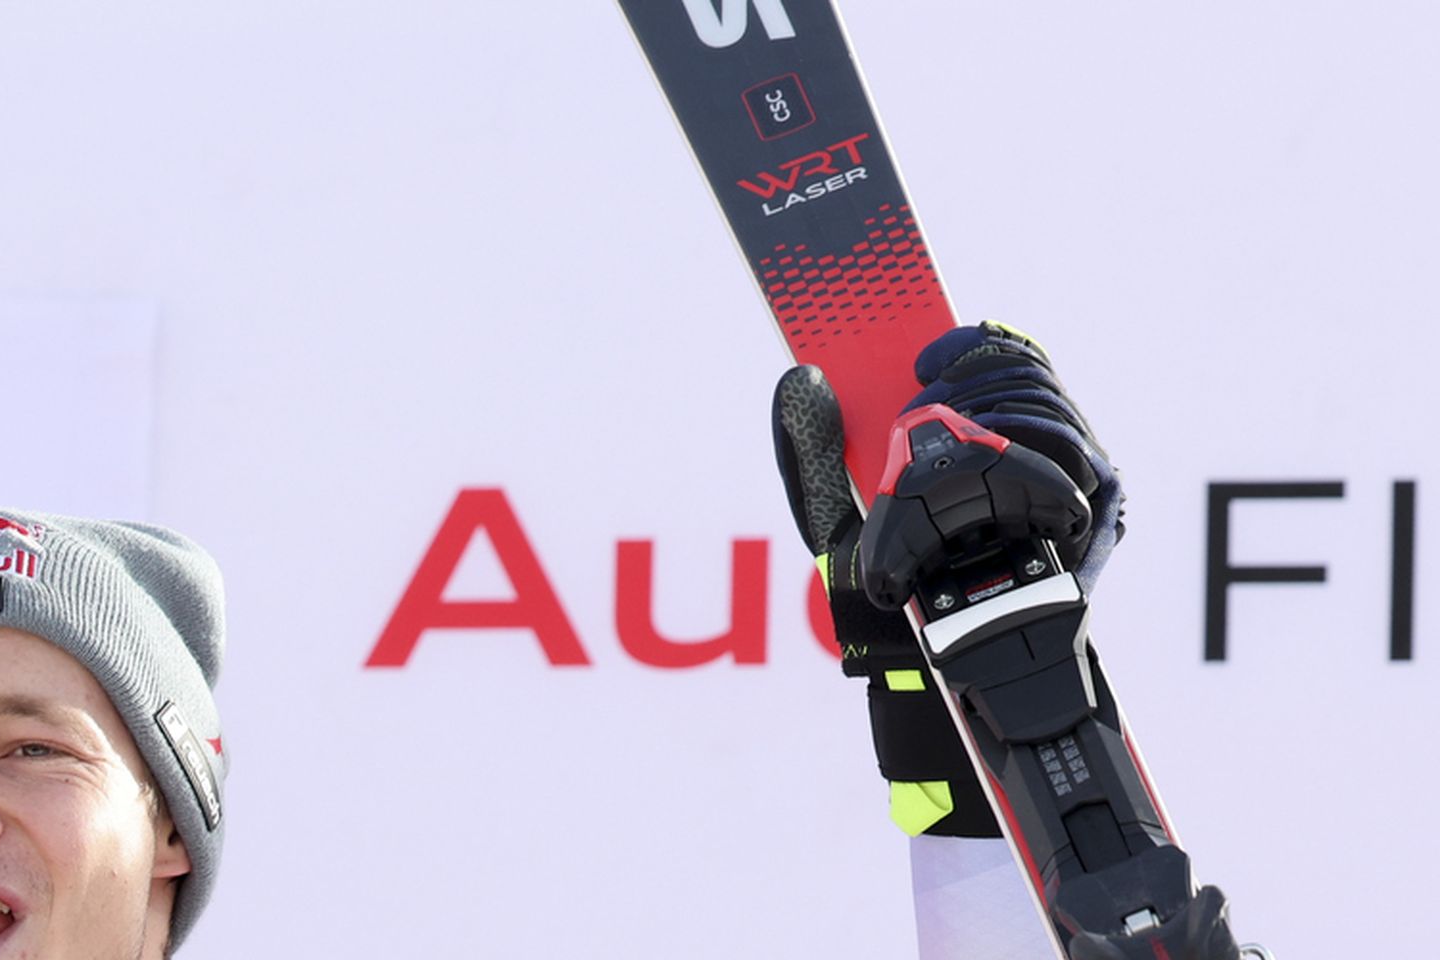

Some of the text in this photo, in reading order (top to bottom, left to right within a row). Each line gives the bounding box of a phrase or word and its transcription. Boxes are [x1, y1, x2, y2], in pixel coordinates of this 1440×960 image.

[765, 89, 791, 122] CSC
[736, 133, 870, 199] WRT
[761, 166, 869, 217] LASER
[362, 486, 846, 669] Au
